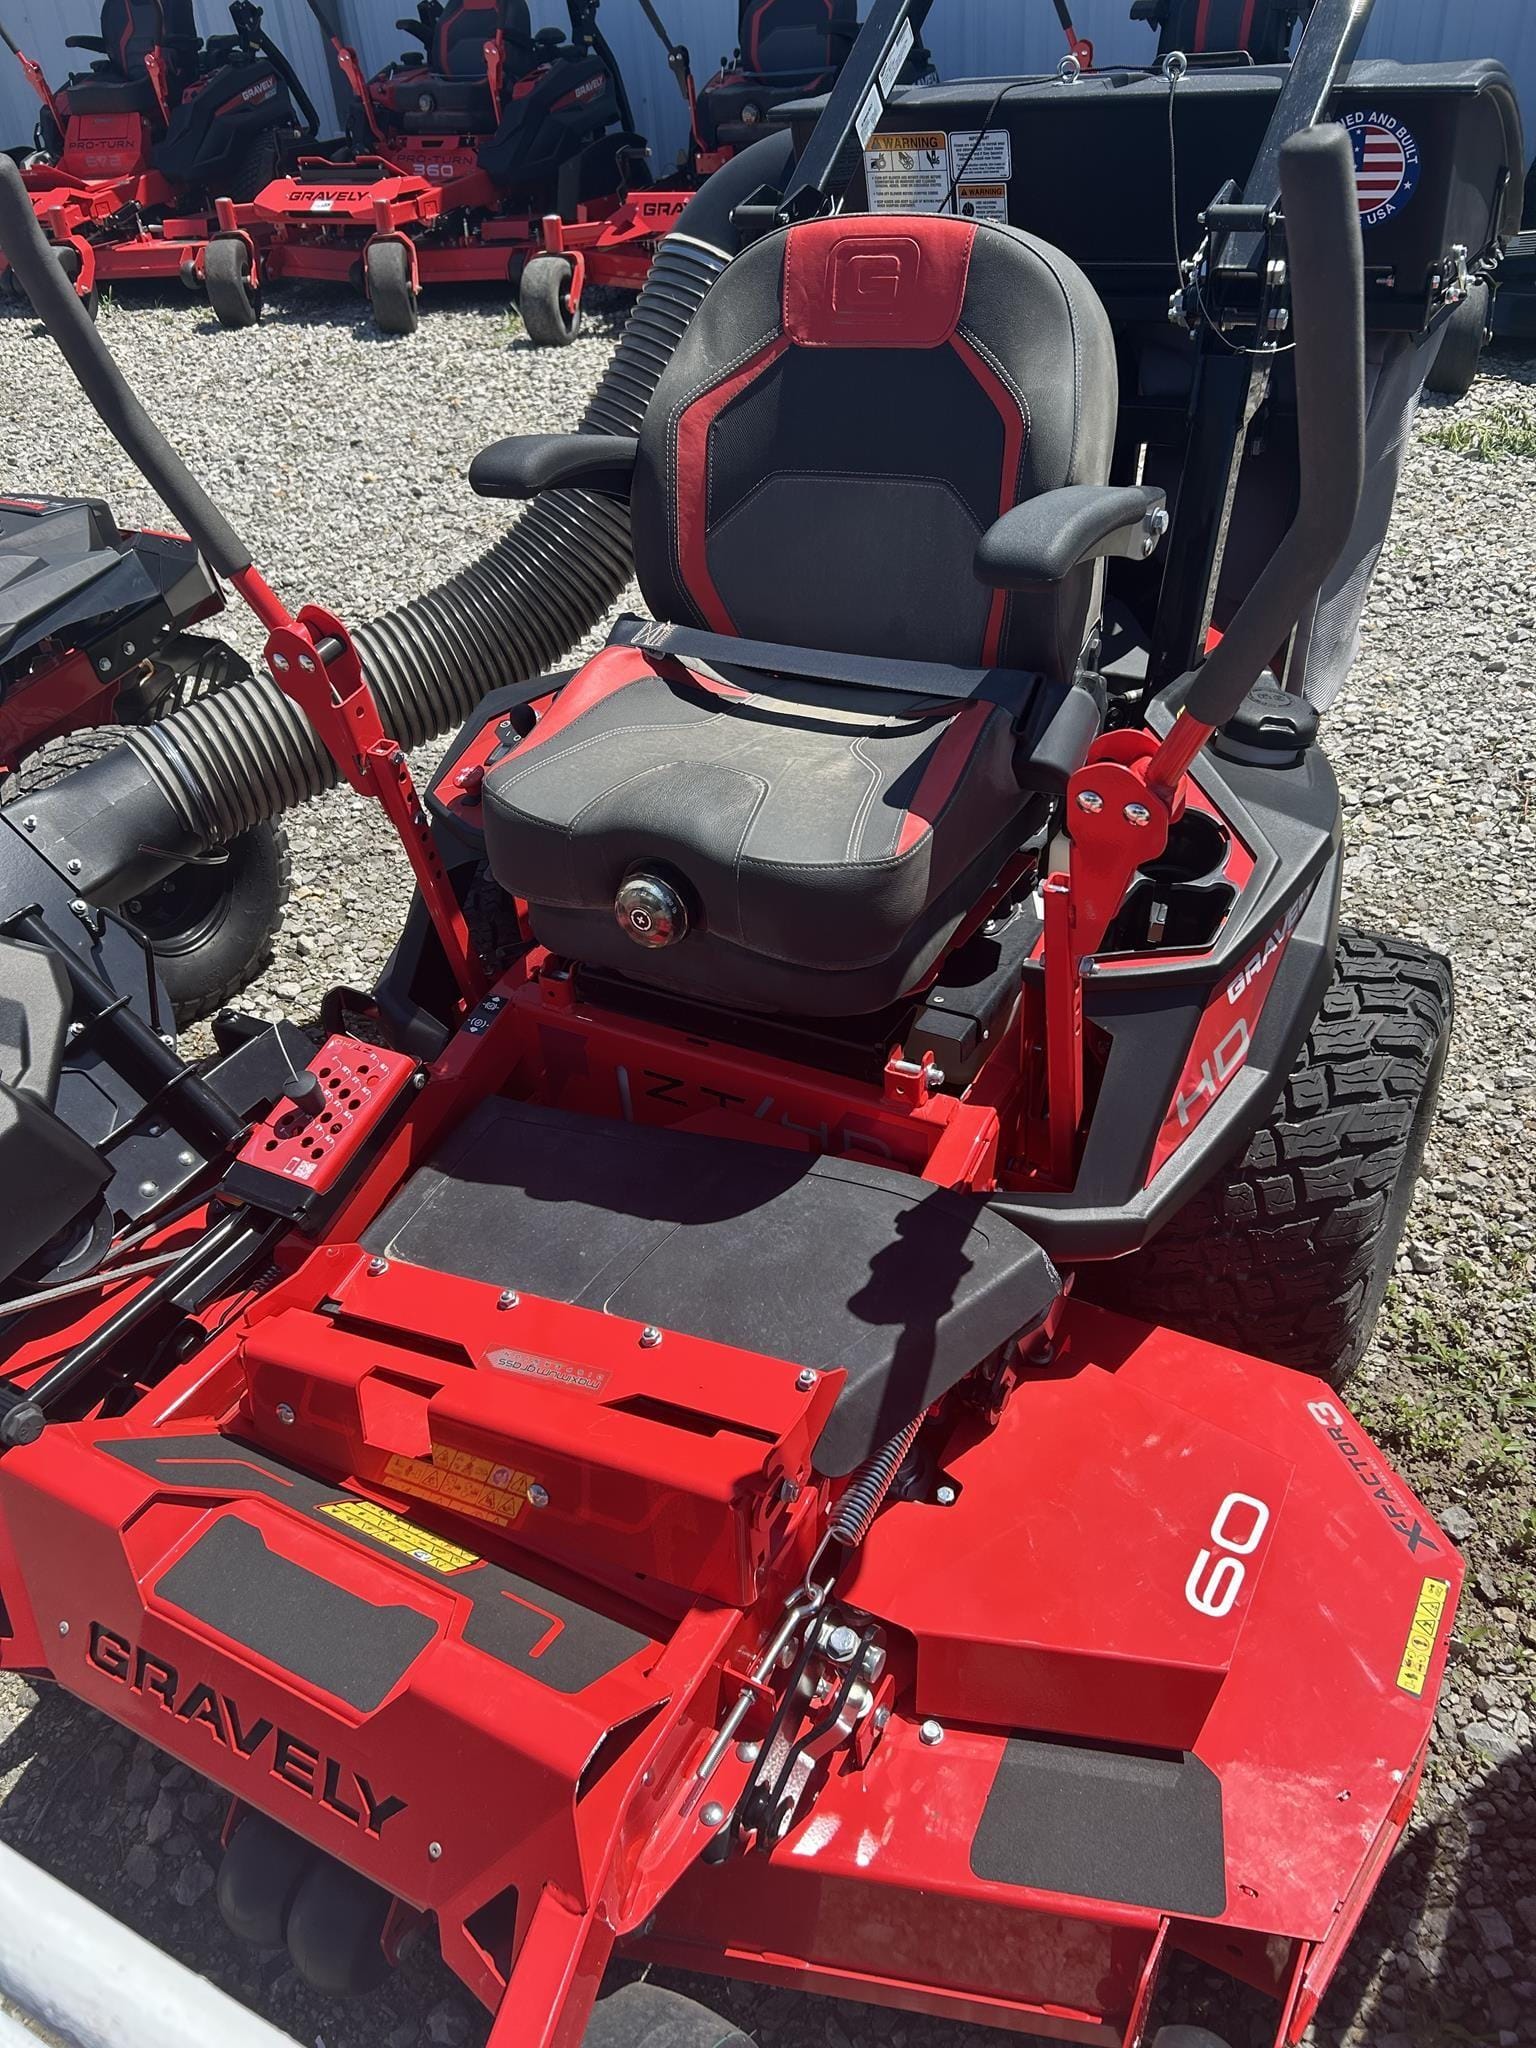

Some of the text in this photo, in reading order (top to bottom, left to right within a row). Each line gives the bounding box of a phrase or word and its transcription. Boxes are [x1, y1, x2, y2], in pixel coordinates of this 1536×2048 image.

[241, 76, 274, 101] GRAVELY
[69, 139, 135, 150] PRO-TURN
[882, 136, 938, 149] WARNING
[1368, 111, 1397, 129] AND
[1395, 126, 1418, 164] BUILT
[396, 154, 474, 166] PRO-TURN
[412, 164, 454, 178] 360
[288, 191, 370, 201] GRAVELY
[968, 187, 1003, 196] WARNING
[1366, 203, 1396, 225] USA
[1176, 1018, 1251, 1127] HD
[1184, 1491, 1270, 1618] 60
[86, 1620, 408, 1840] GRAVELY
